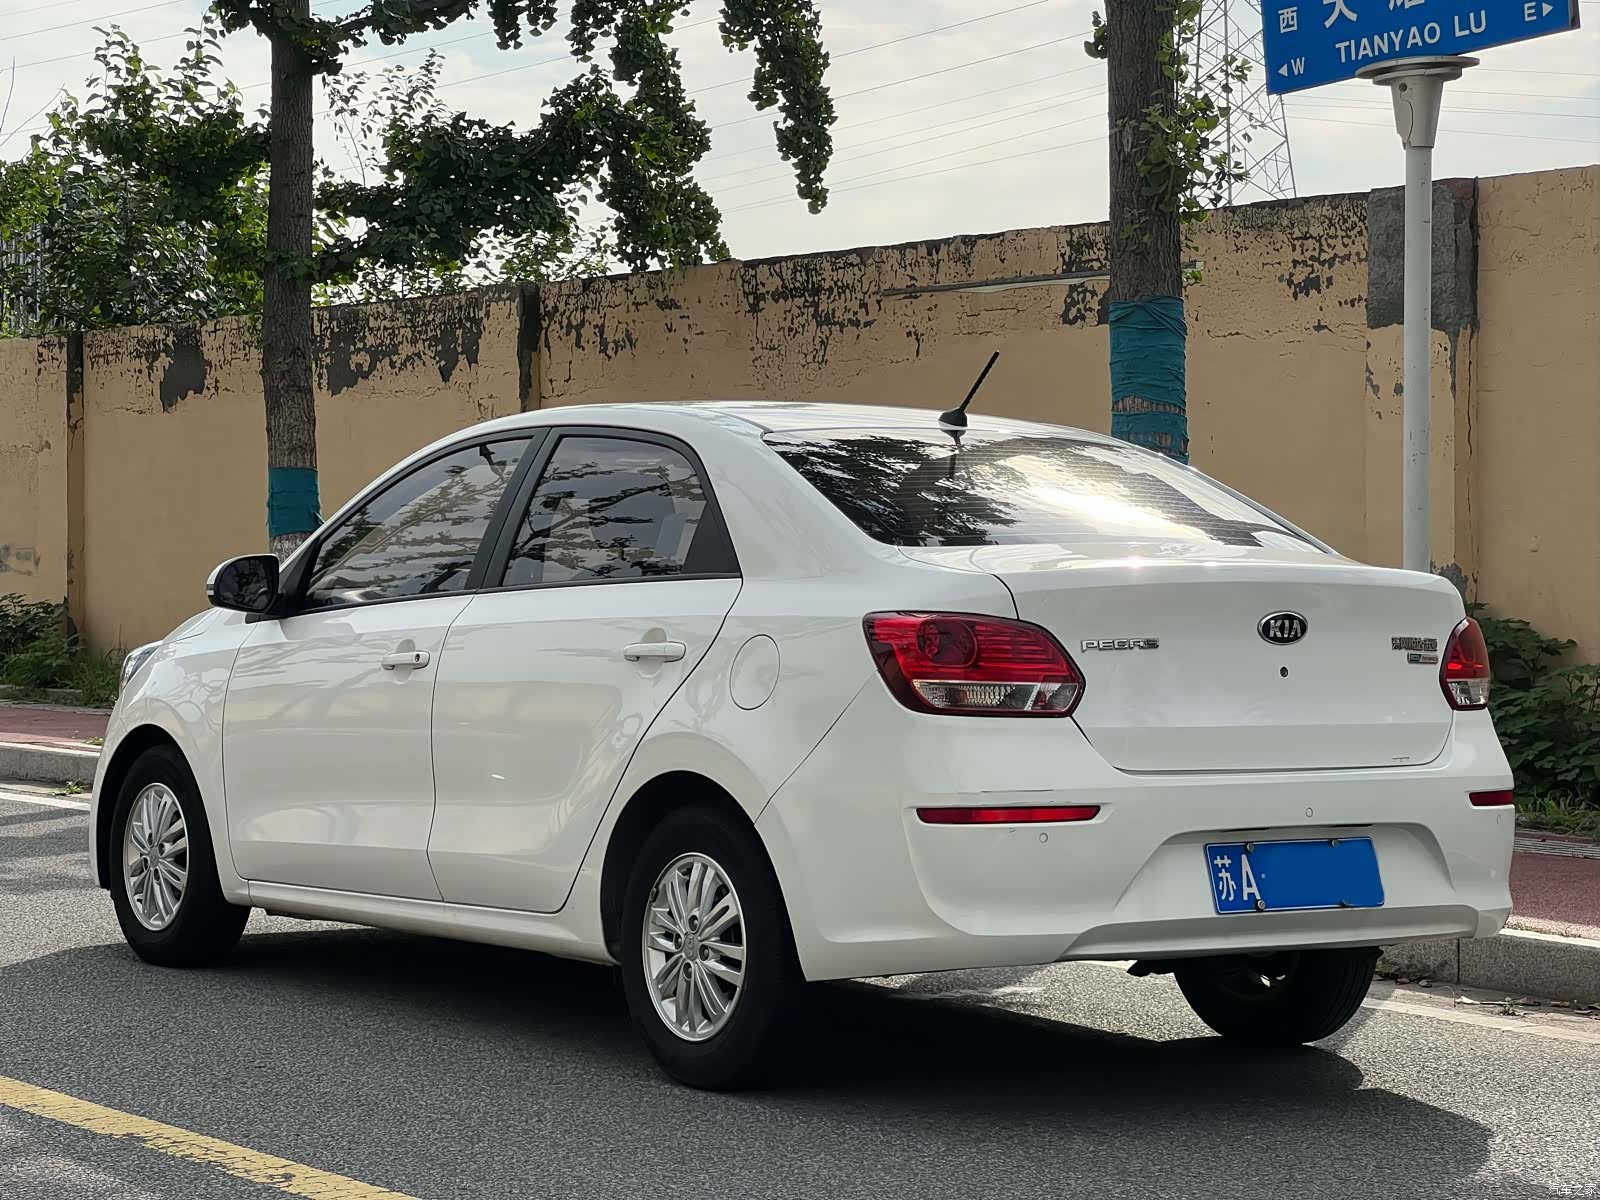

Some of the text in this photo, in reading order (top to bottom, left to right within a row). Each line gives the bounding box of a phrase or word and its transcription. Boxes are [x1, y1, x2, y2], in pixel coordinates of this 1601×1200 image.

[1278, 6, 1298, 34] 西
[1523, 1, 1537, 21] E
[1335, 9, 1487, 63] TIANYAO LU
[1290, 56, 1305, 76] W
[1269, 619, 1302, 638] KIA
